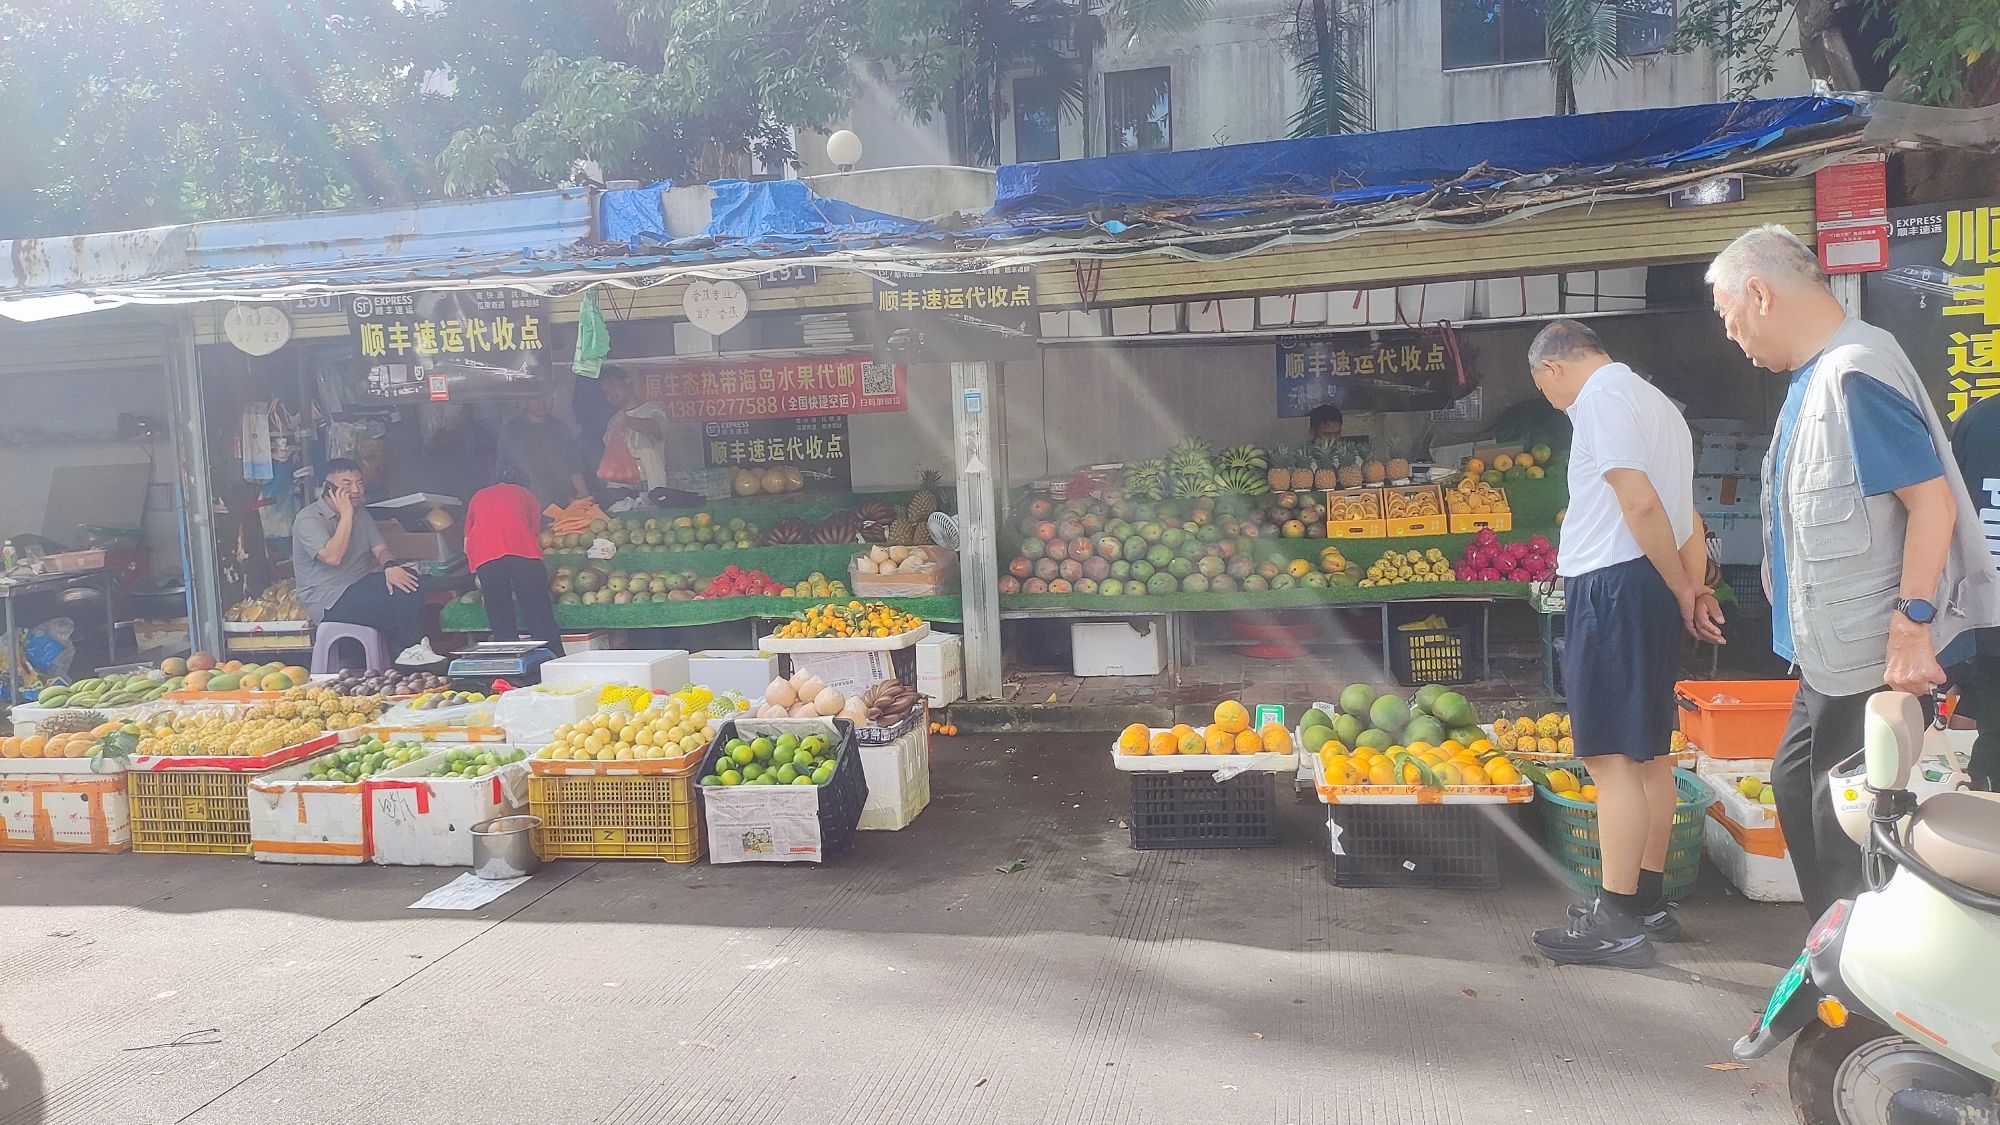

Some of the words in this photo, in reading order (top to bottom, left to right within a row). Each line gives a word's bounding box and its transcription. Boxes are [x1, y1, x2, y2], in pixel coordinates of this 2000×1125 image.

[1897, 216, 1942, 227] EXPRESS
[1897, 225, 1942, 236] 顺丰速运
[767, 265, 805, 281] 191
[374, 296, 413, 306] EXPRESS
[879, 284, 1031, 312] 顺丰速运代收点
[375, 305, 414, 316] 顺丰速运
[360, 314, 543, 358] 顺丰速运代收点
[1285, 343, 1446, 379] 顺丰速运代收点
[645, 363, 855, 398] 原生态热带海岛水果代邮
[667, 396, 778, 418] 13876277588
[710, 434, 844, 465] 顺丰速运代收点
